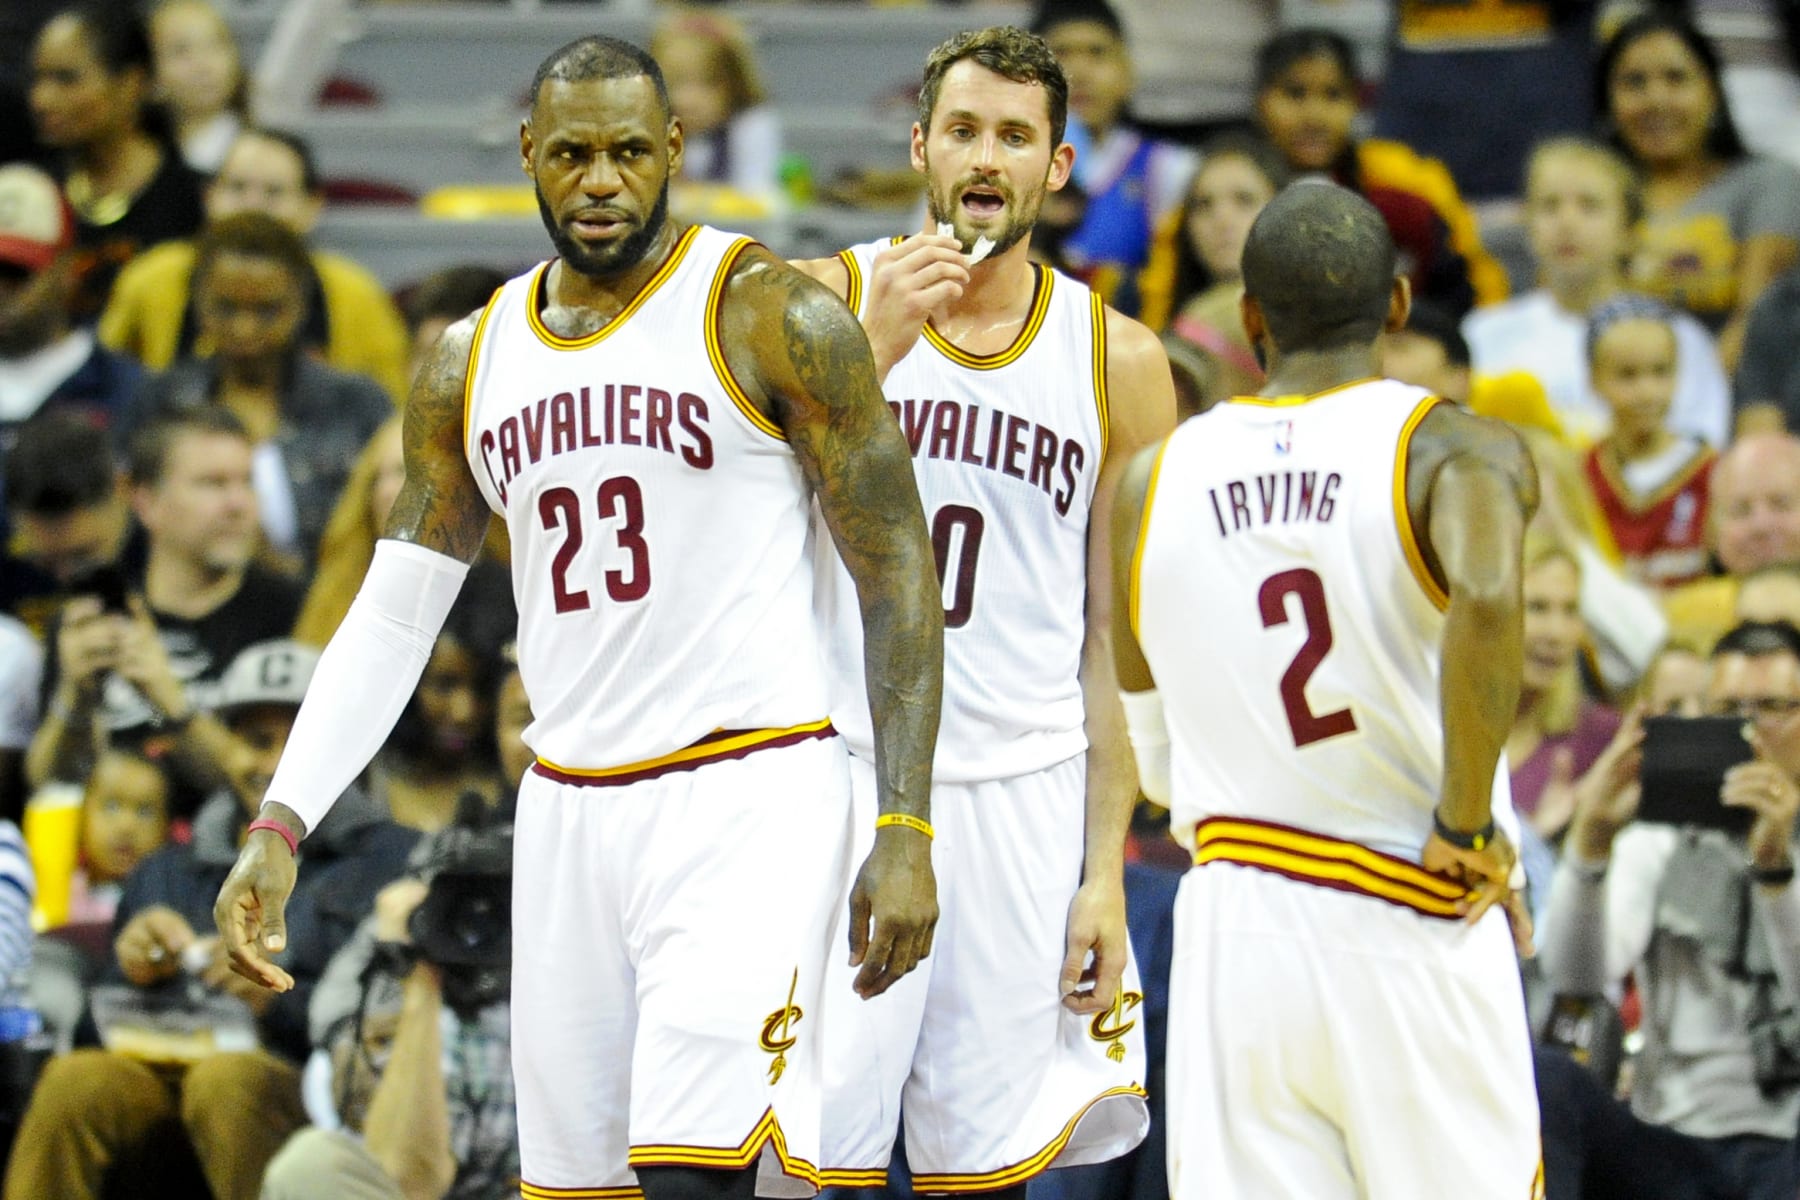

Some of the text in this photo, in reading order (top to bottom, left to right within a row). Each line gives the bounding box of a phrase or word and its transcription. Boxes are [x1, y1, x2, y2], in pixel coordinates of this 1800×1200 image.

[480, 384, 714, 509] CAVALIERS
[888, 399, 1085, 517] VALIERS
[1209, 471, 1342, 537] IRVING
[538, 475, 652, 615] 23
[931, 503, 985, 629] 0
[1257, 567, 1358, 748] 2
